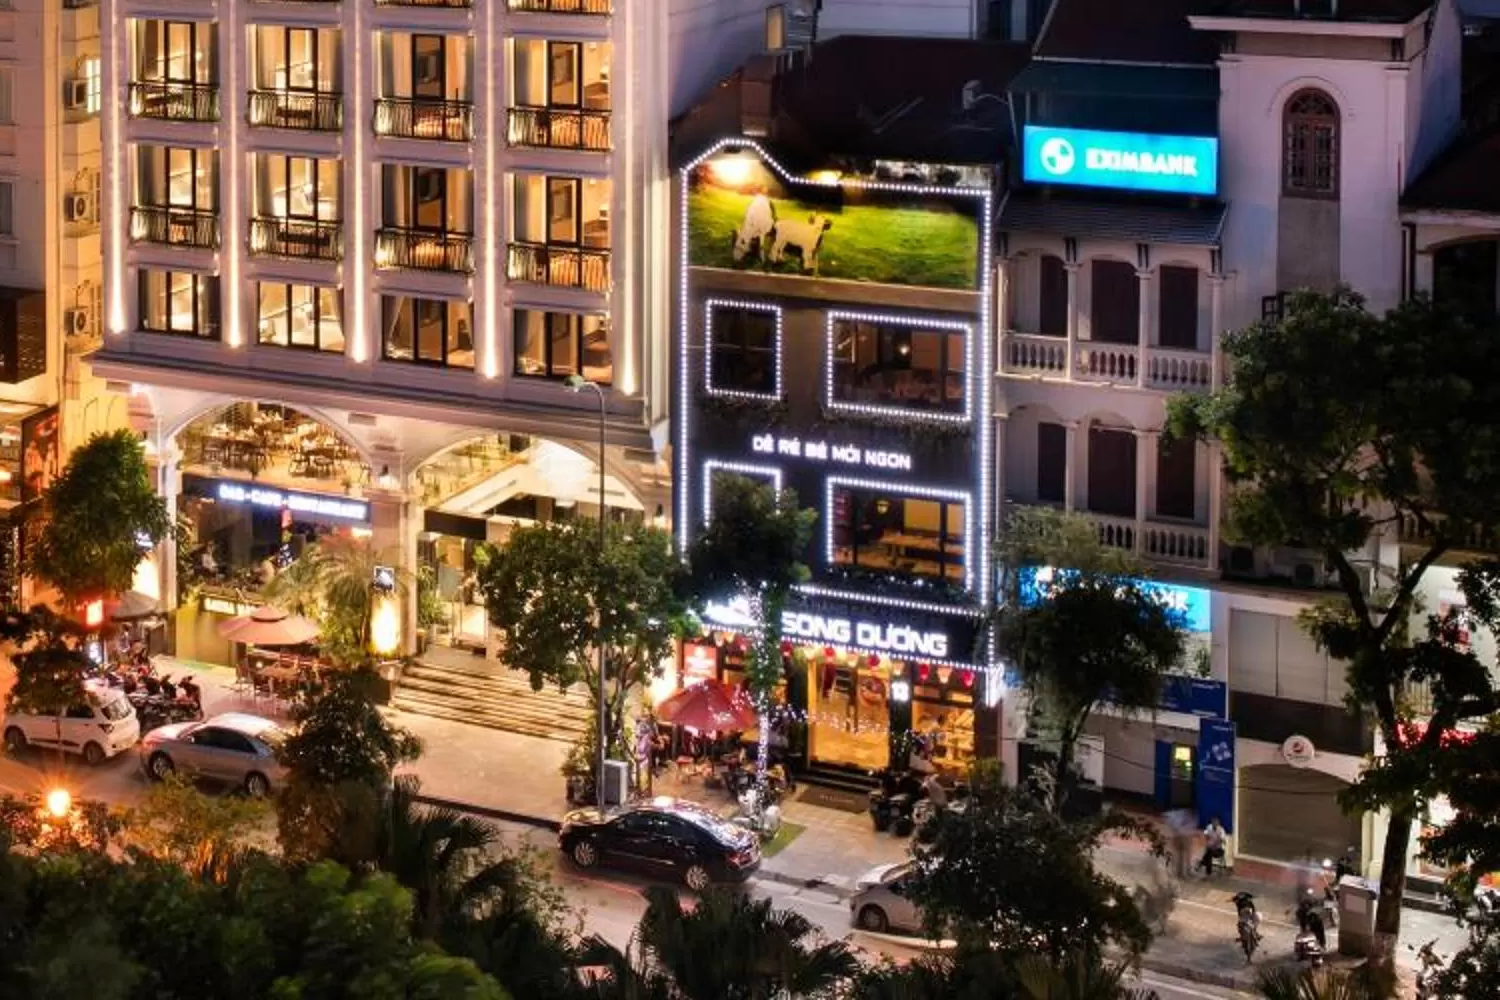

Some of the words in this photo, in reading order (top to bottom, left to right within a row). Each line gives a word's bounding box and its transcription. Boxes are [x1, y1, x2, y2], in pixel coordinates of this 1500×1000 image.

[1086, 147, 1198, 177] EXIMBANK
[865, 449, 912, 471] NGON
[781, 611, 851, 643] SONG
[857, 622, 948, 657] DƯƠNG
